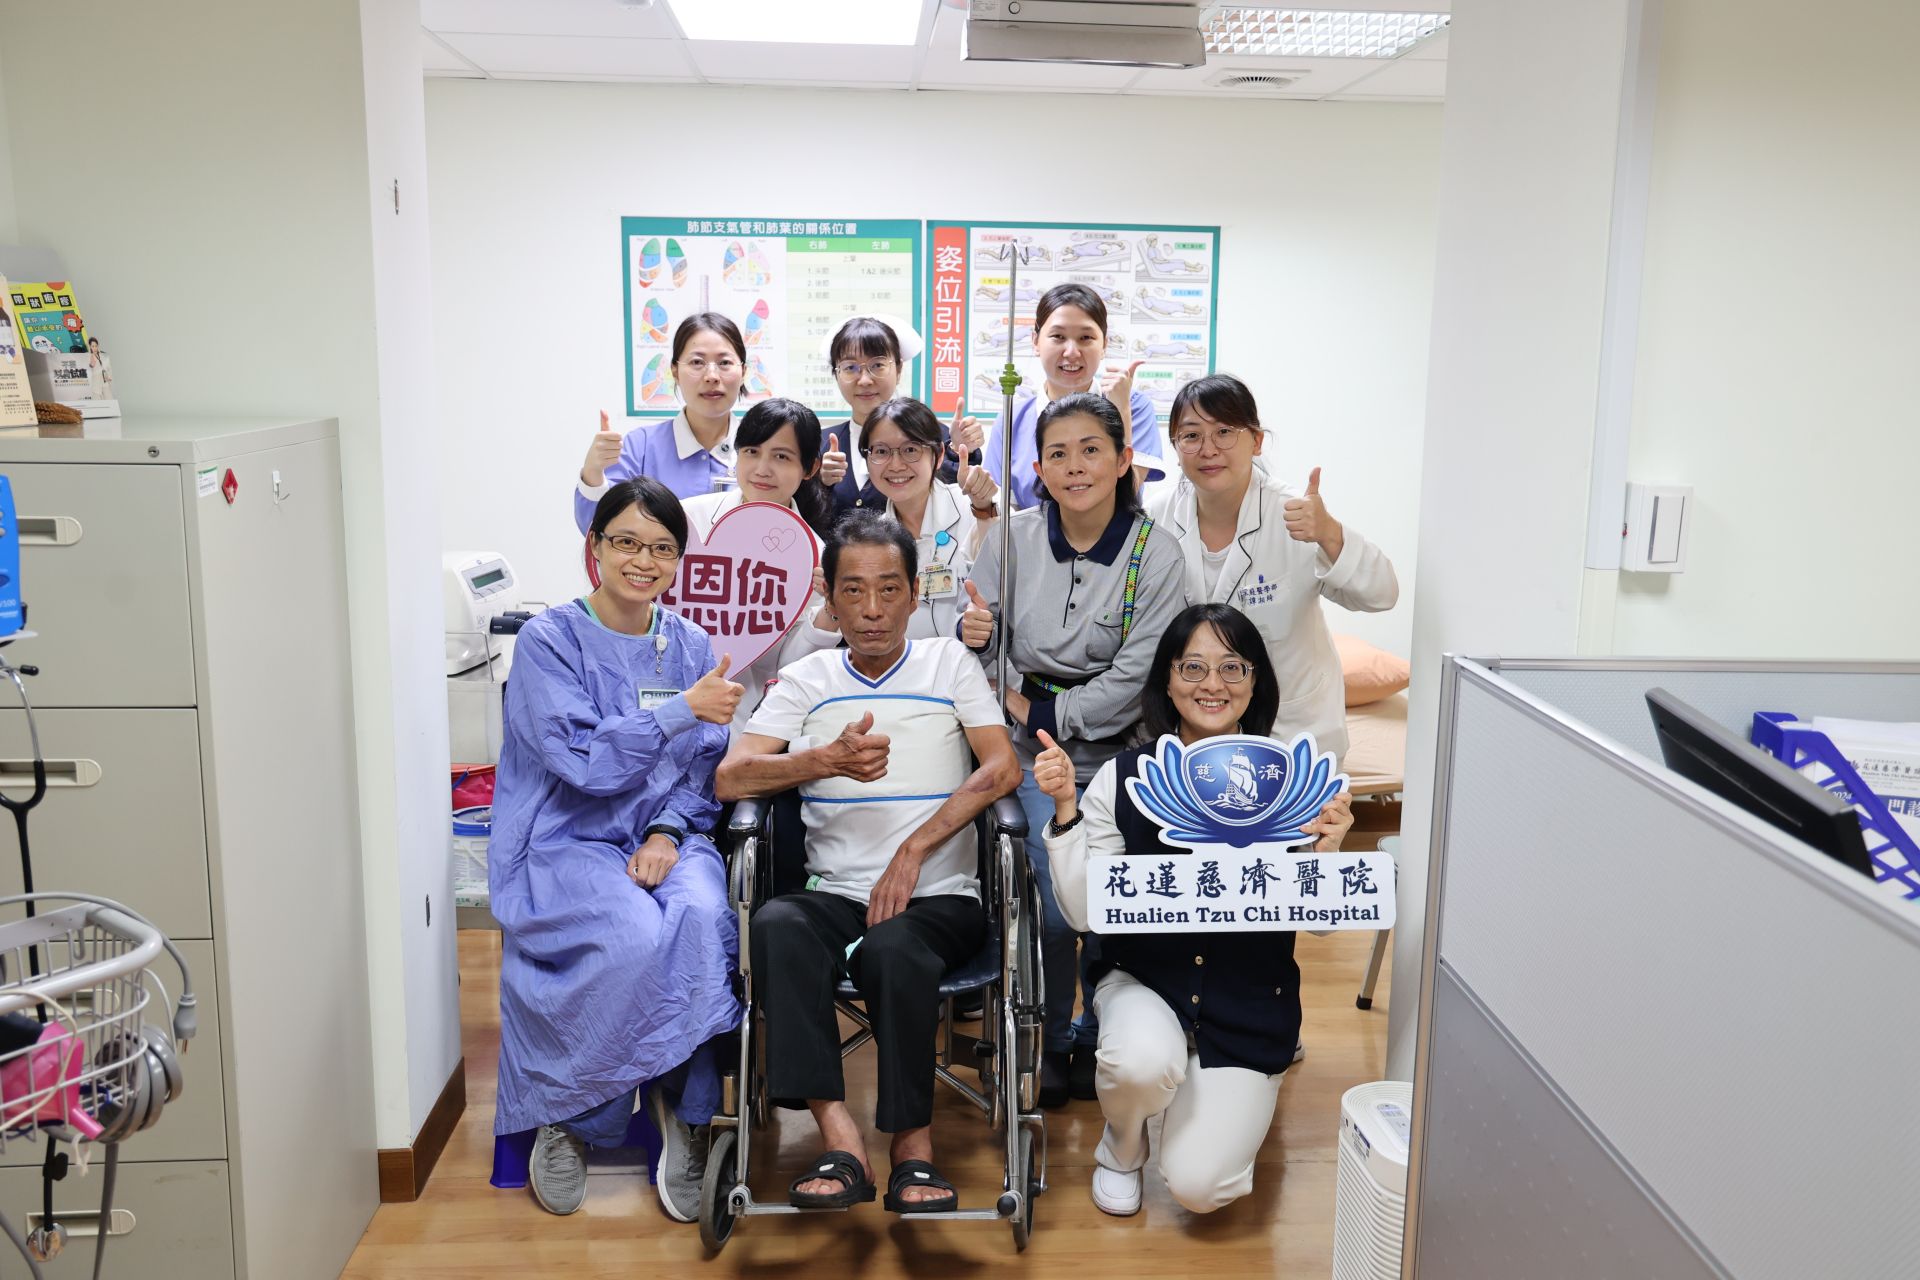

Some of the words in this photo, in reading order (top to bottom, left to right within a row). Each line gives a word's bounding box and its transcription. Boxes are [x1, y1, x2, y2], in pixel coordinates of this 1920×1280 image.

[687, 220, 858, 235] 肺節支氣管和肺葉的關係位置
[809, 240, 828, 250] 右肺
[872, 240, 890, 250] 左肺
[935, 245, 963, 394] 姿位引流圖
[1194, 763, 1217, 782] 慈
[1258, 763, 1285, 782] 濟
[1104, 857, 1379, 900] 花蓮慈濟醫院
[1105, 905, 1190, 924] Hualien
[1195, 905, 1236, 923] Tzu
[1243, 904, 1281, 922] Chi
[1287, 903, 1380, 925] Hospital
